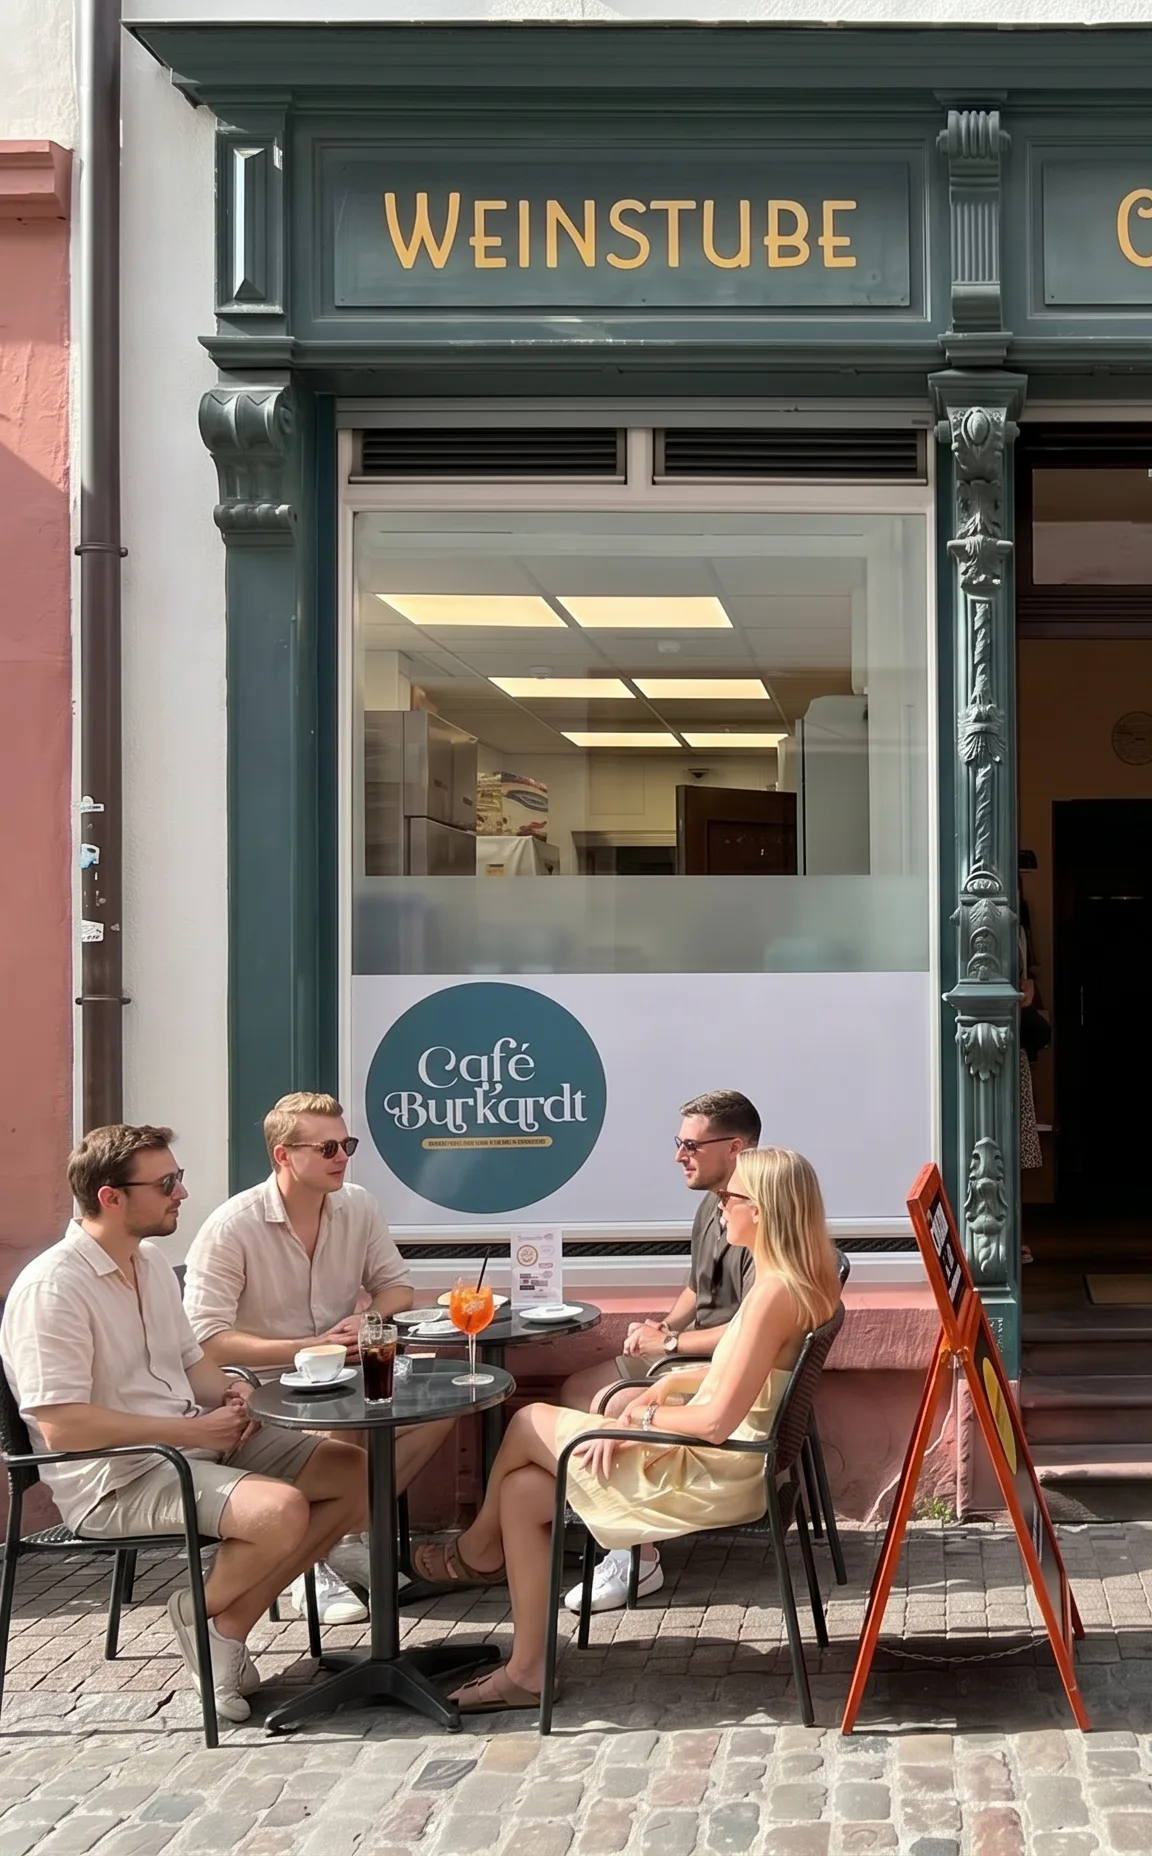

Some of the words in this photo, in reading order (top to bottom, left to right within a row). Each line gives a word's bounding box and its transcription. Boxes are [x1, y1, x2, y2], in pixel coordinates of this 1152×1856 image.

[384, 191, 857, 270] WEINSTUBE
[417, 1037, 536, 1089] Café
[383, 1081, 588, 1134] Burkardt
